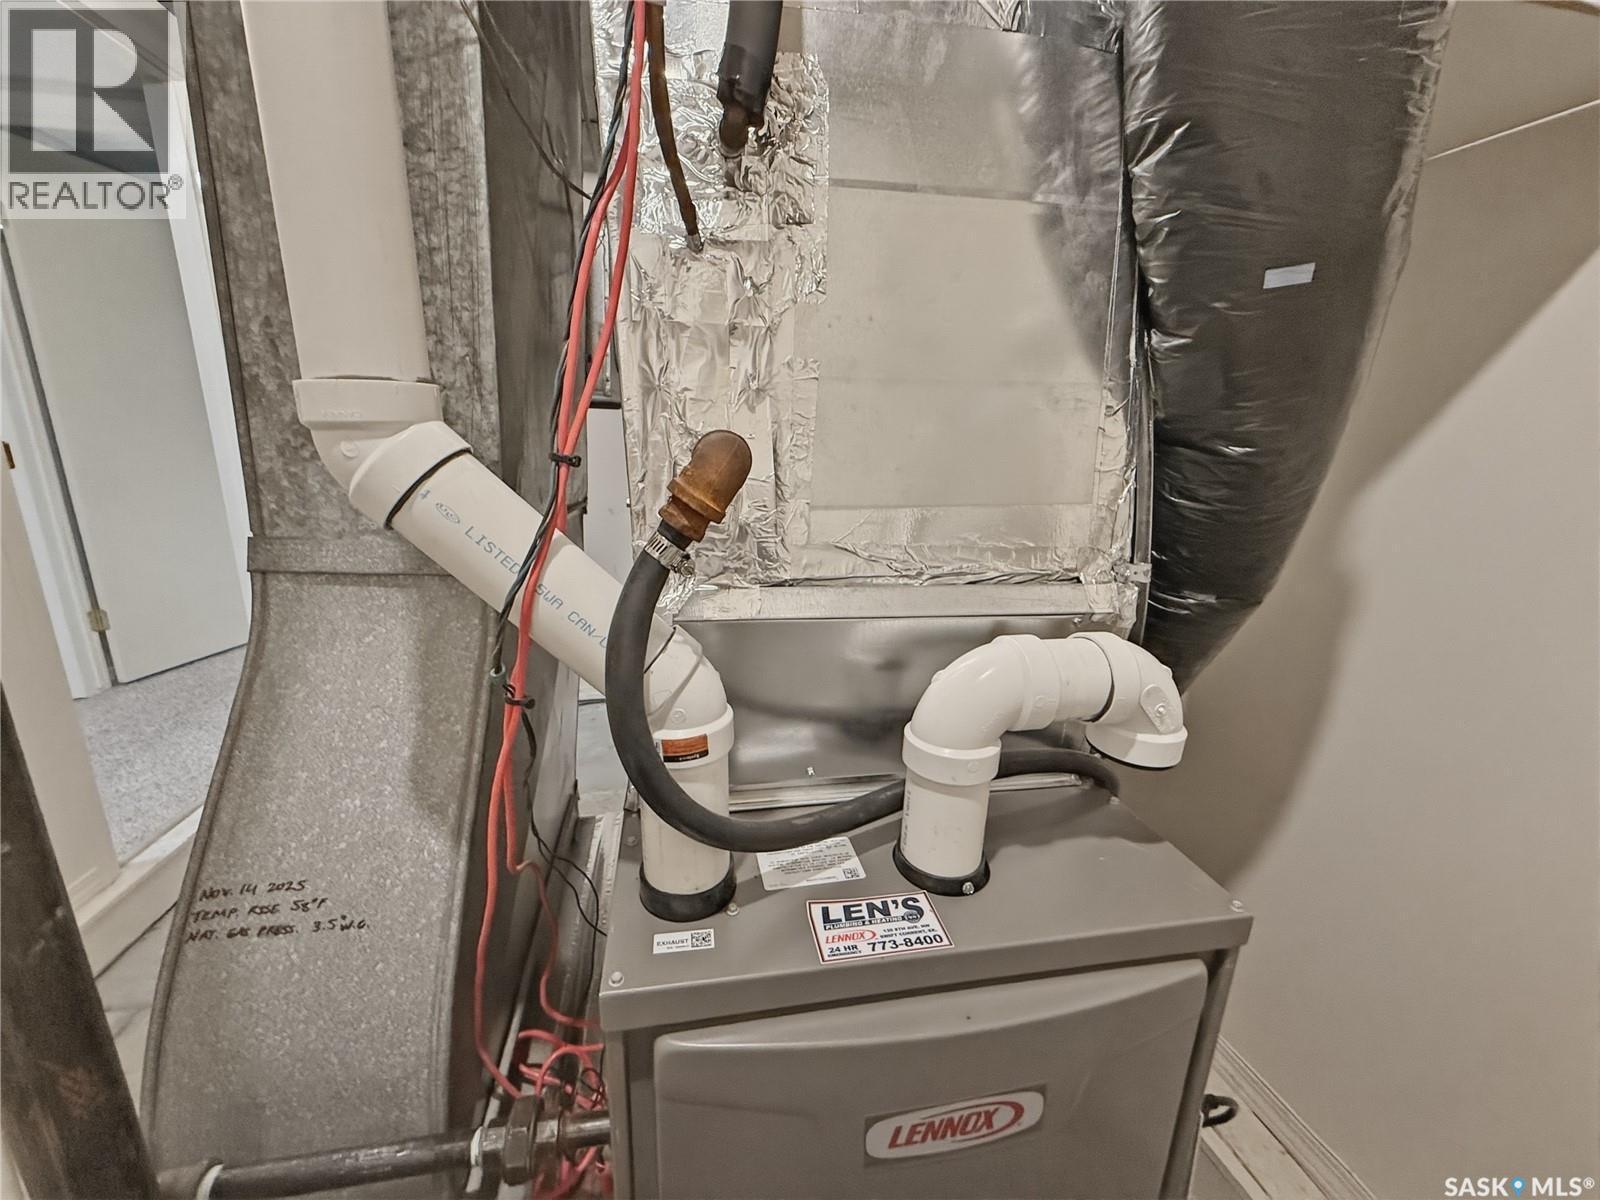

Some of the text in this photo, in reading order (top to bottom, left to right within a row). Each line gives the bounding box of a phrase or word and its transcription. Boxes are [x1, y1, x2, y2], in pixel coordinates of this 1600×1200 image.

[464, 525, 521, 575] LISTED
[267, 880, 308, 893] 2025
[821, 896, 925, 925] LEN'S
[825, 919, 863, 931] PLUMBING
[871, 916, 903, 924] HEATING
[656, 938, 689, 946] EXHAUST
[825, 931, 866, 944] LENNOX
[867, 933, 944, 952] 773-8400
[828, 946, 841, 954] 24
[888, 1106, 1000, 1150] LENNOX
